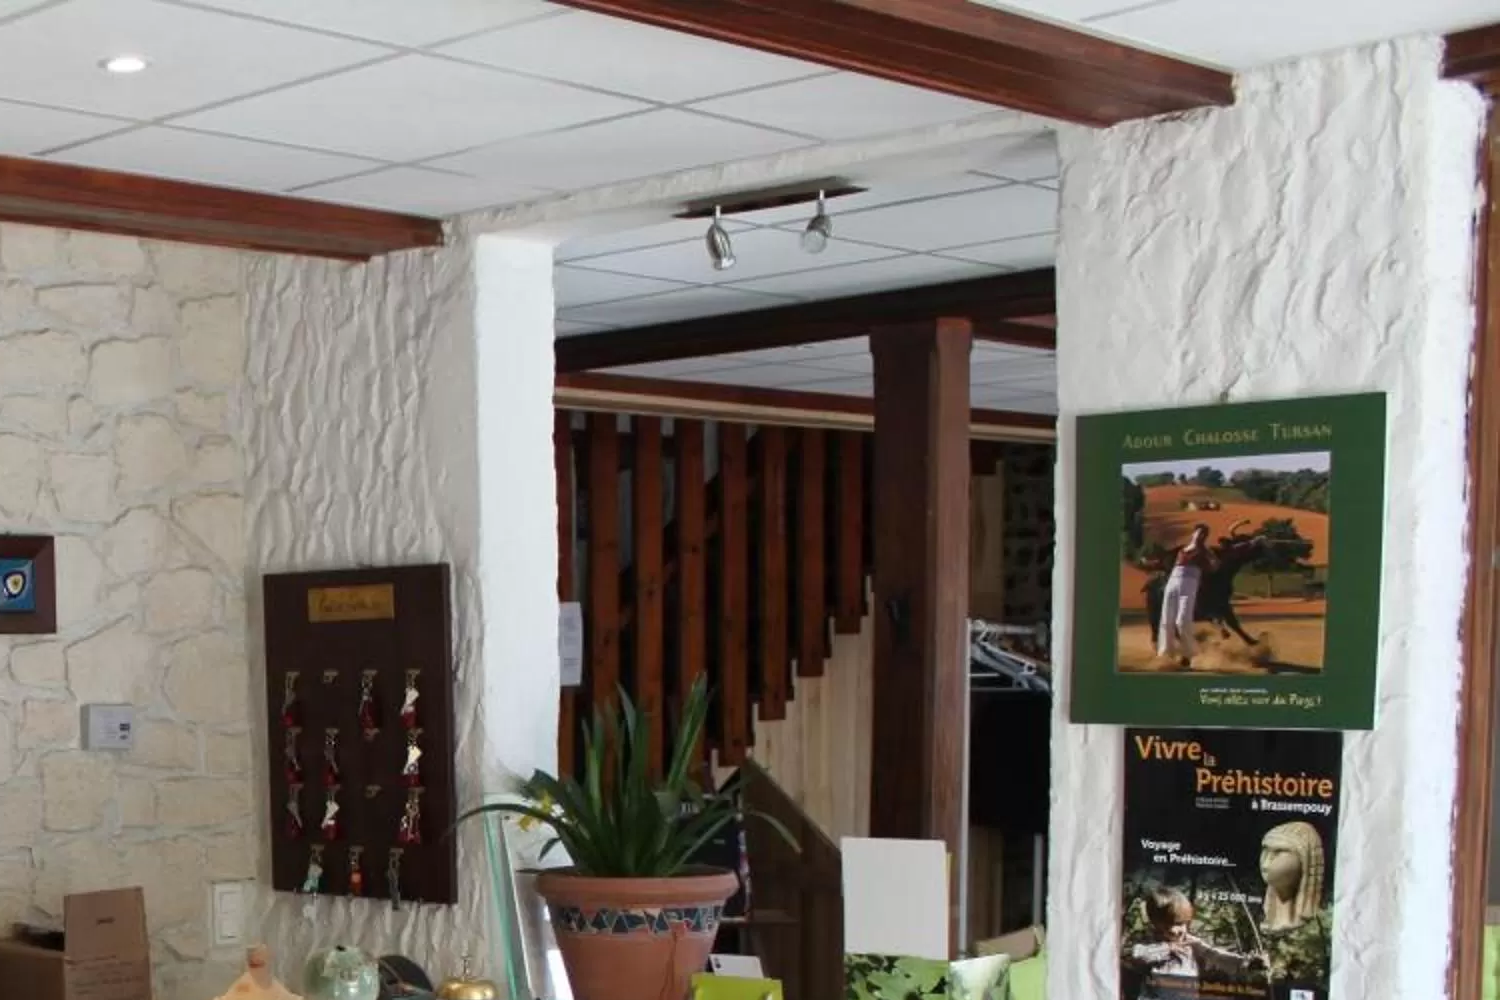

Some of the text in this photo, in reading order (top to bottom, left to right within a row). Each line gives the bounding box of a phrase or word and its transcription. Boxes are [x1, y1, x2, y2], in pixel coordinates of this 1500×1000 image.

[1134, 735, 1201, 760] Vivre
[1203, 752, 1216, 767] la
[1195, 767, 1333, 798] Préhistoire
[1252, 798, 1332, 816] à Brassempouy
[1141, 839, 1182, 852] Voyage
[1153, 854, 1167, 863] en
